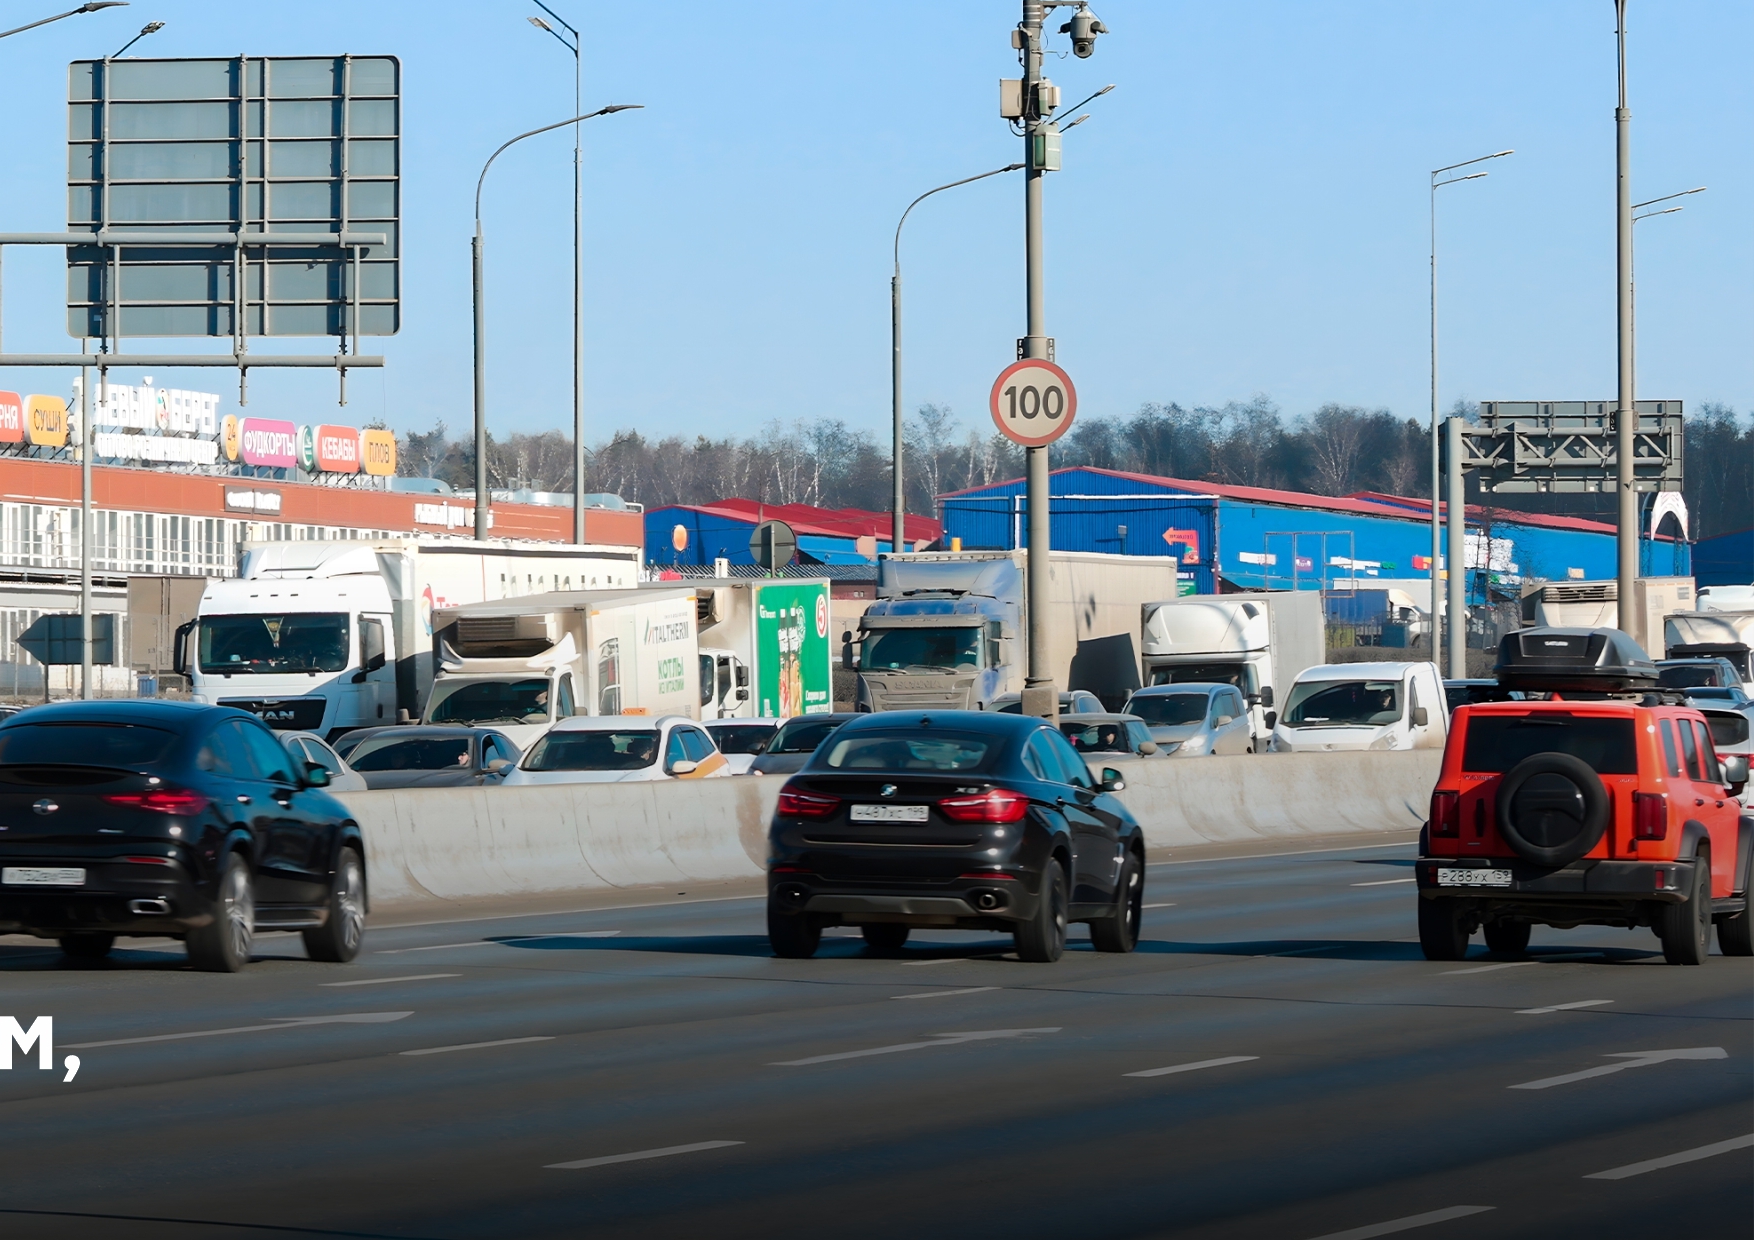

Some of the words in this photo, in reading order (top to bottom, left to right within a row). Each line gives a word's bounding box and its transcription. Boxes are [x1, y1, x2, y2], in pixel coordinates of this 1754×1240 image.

[168, 389, 220, 435] БЕРЕГ
[1004, 385, 1064, 419] 100
[34, 408, 62, 433] СУШИ
[245, 430, 296, 458] ФУДКОРТЫ
[321, 436, 356, 461] КЕБАБЫ
[369, 441, 390, 464] ПЛОВ
[658, 656, 684, 680] КОТЛЫ
